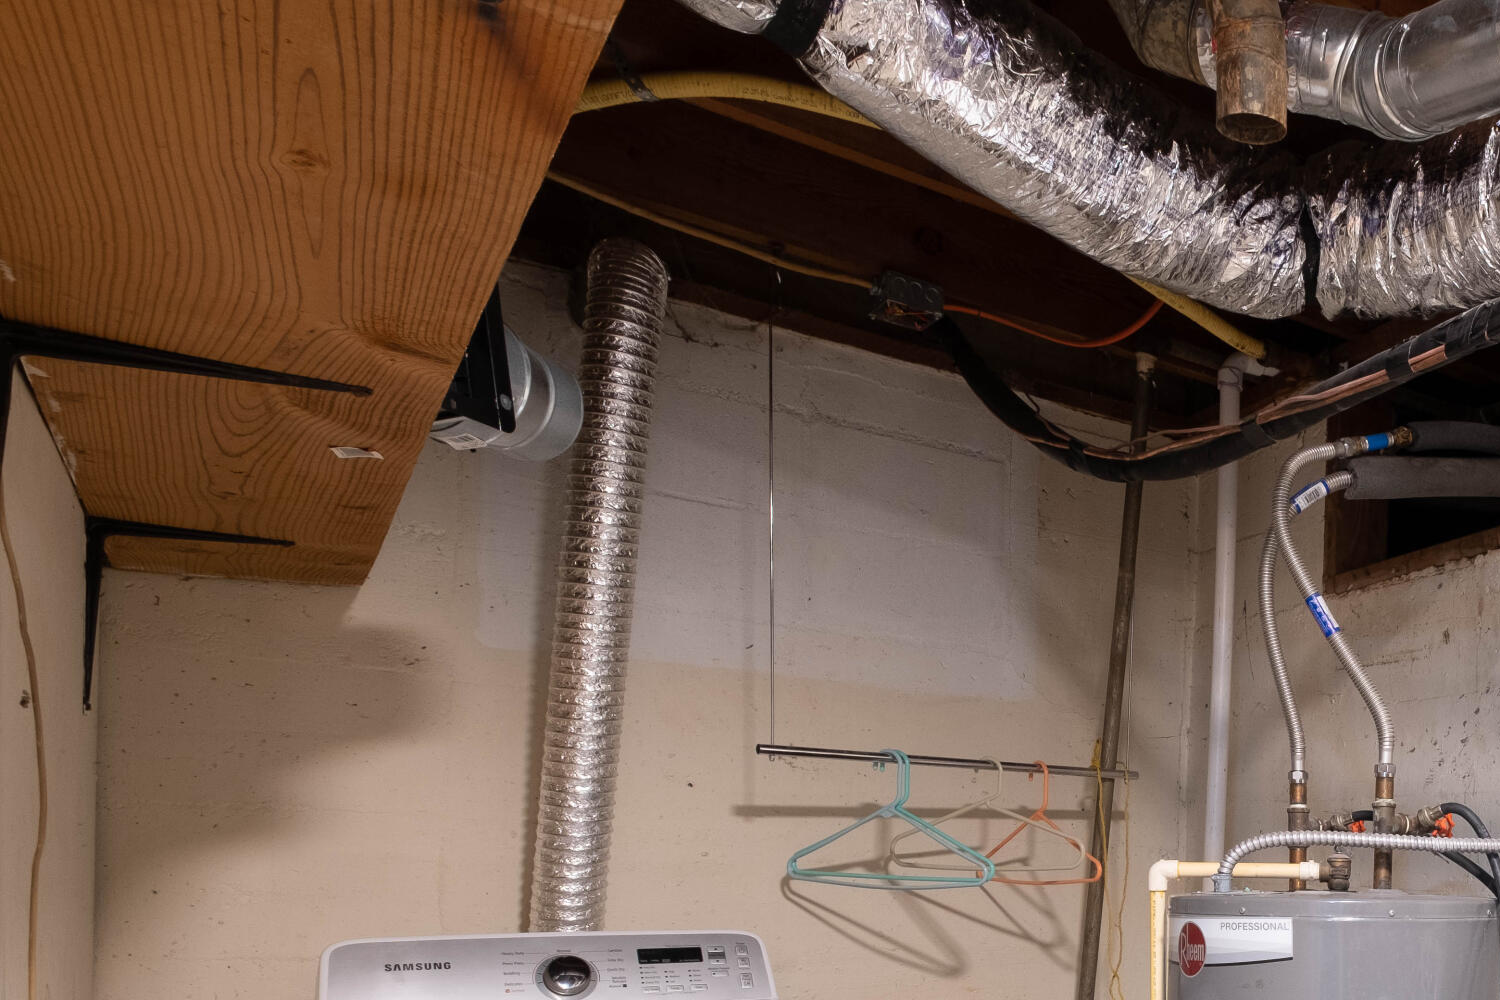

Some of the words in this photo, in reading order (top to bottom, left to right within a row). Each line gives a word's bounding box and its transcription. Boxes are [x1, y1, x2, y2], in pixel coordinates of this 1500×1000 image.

[1220, 922, 1289, 931] PROFESSIONAL
[1181, 923, 1204, 968] Rheem
[384, 962, 451, 972] SAMSUNG
